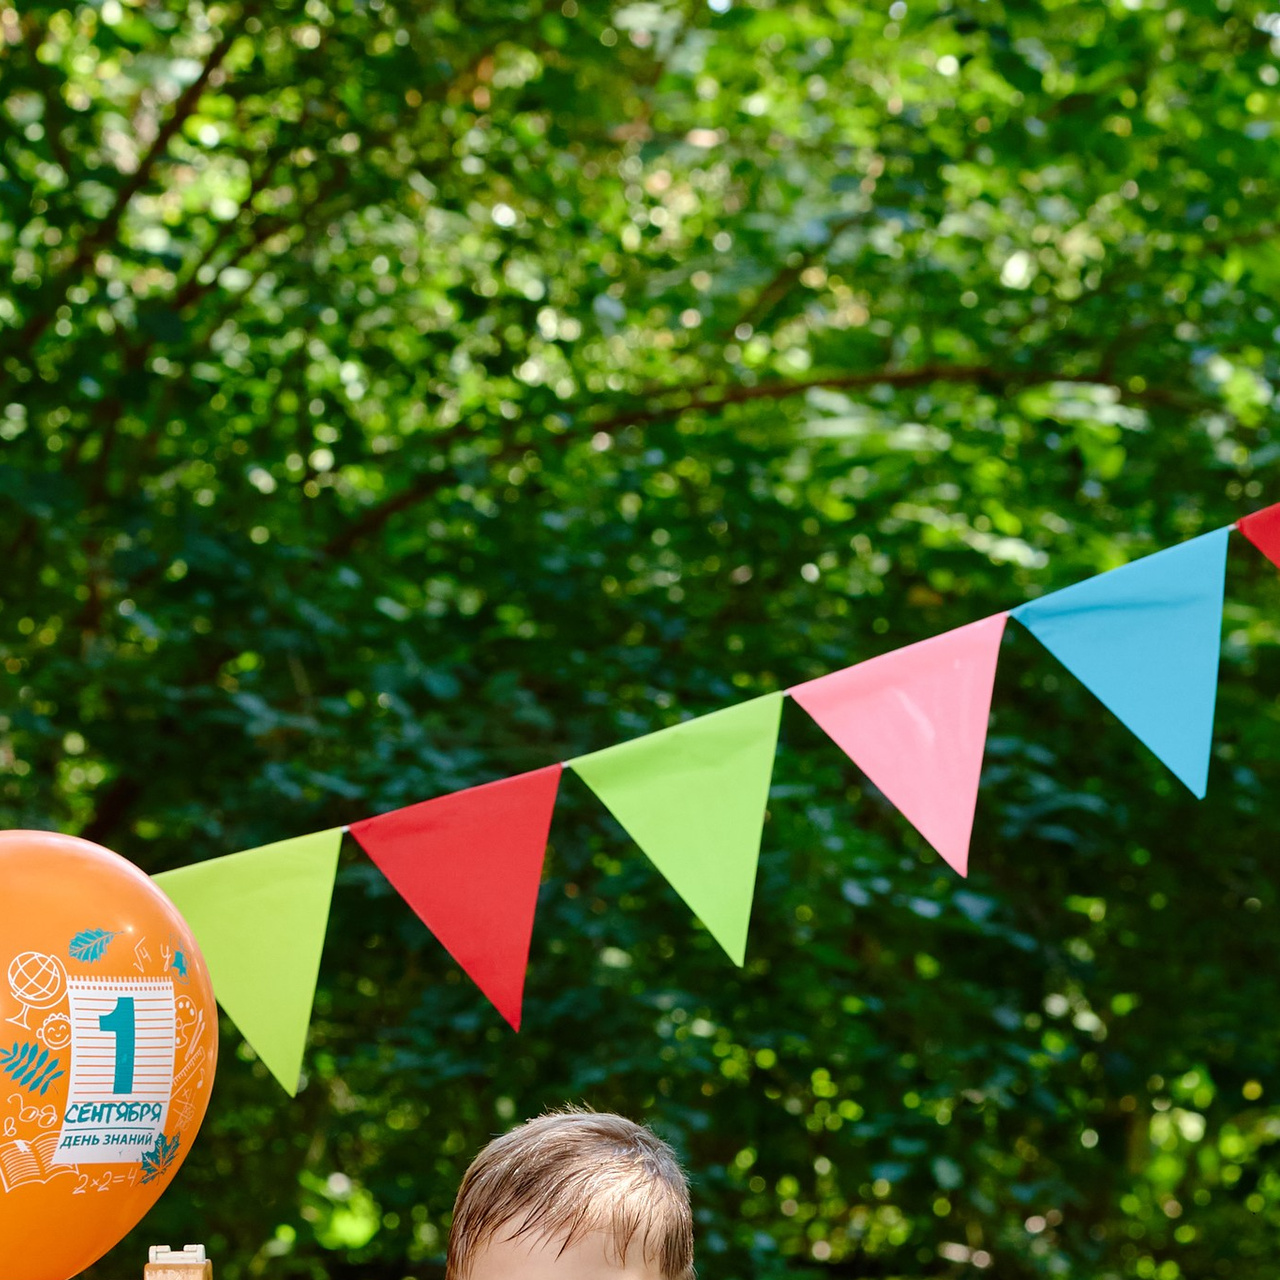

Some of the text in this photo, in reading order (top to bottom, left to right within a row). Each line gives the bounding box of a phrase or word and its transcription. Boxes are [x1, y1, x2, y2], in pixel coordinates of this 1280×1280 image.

[98, 996, 135, 1095] 1
[63, 1101, 163, 1125] СЕНТЯБРЯ
[59, 1132, 153, 1149] ДЕНЬ ЗНАНИЙ
